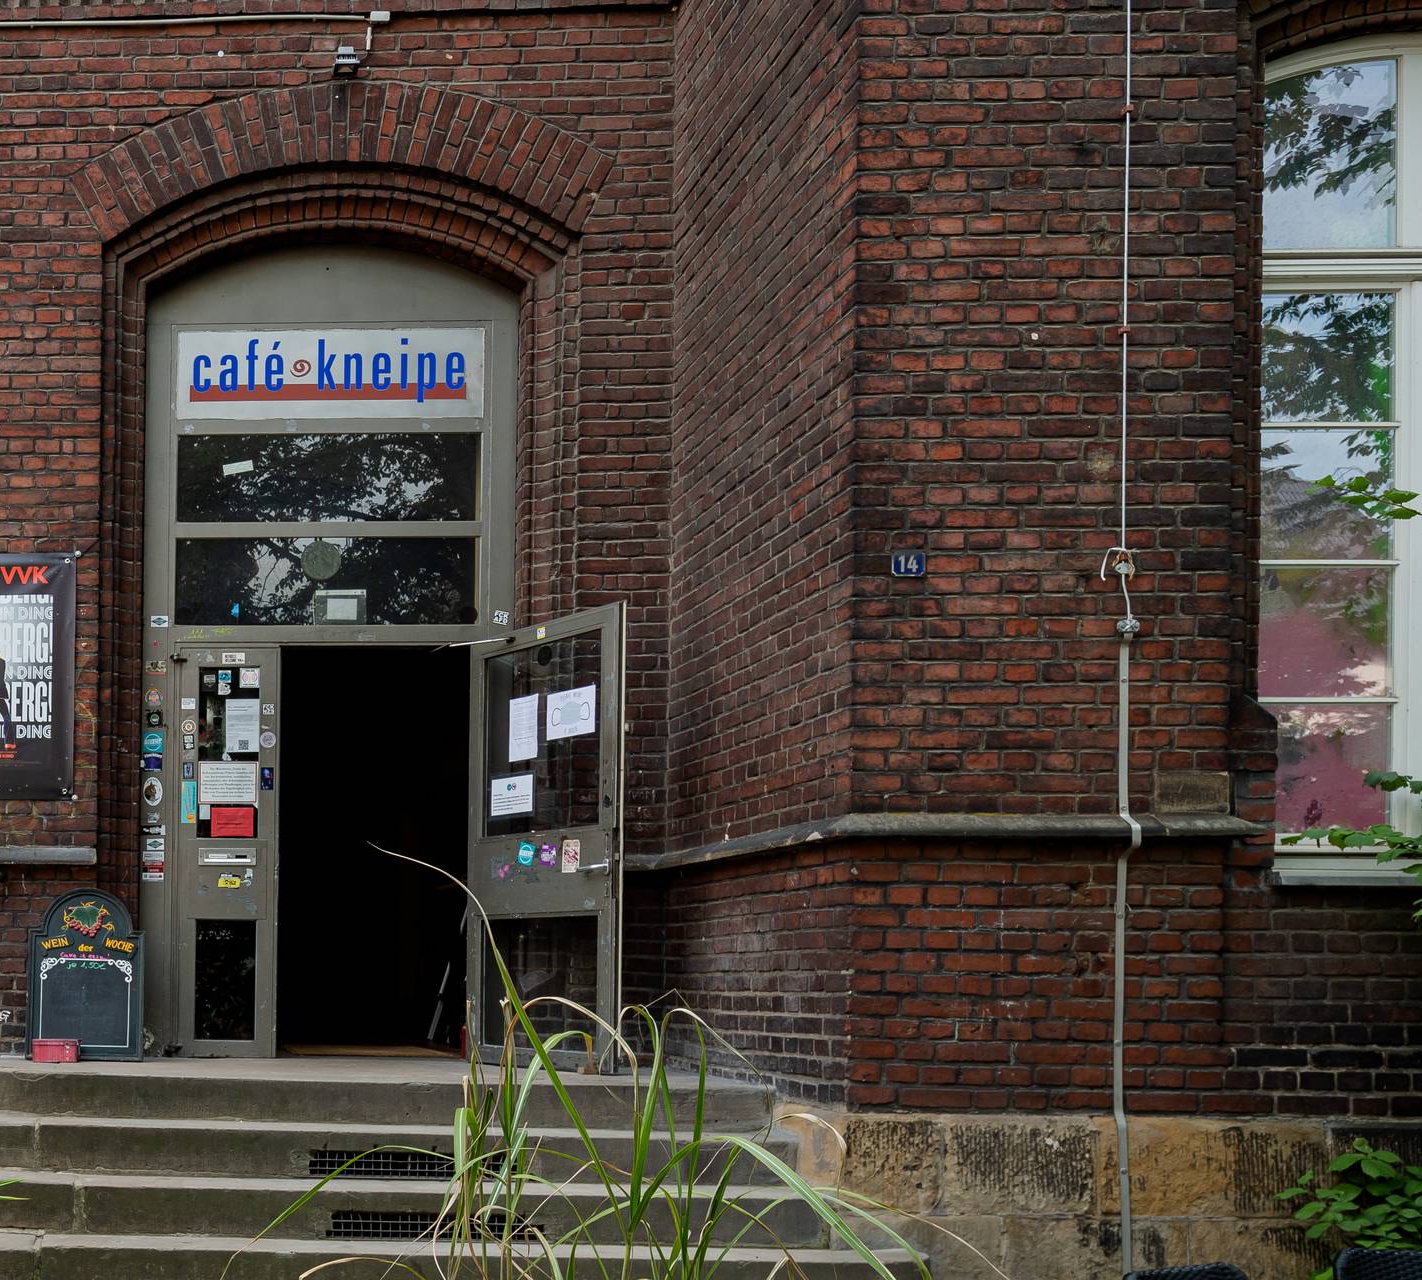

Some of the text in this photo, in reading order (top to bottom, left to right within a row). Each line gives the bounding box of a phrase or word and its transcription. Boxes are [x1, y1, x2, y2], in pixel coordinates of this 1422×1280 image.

[193, 338, 465, 403] café kneipe
[898, 554, 919, 573] 14
[0, 566, 49, 585] VVK
[18, 606, 54, 621] DING
[16, 724, 52, 739] DING
[41, 936, 135, 954] WEIN der WOCHE
